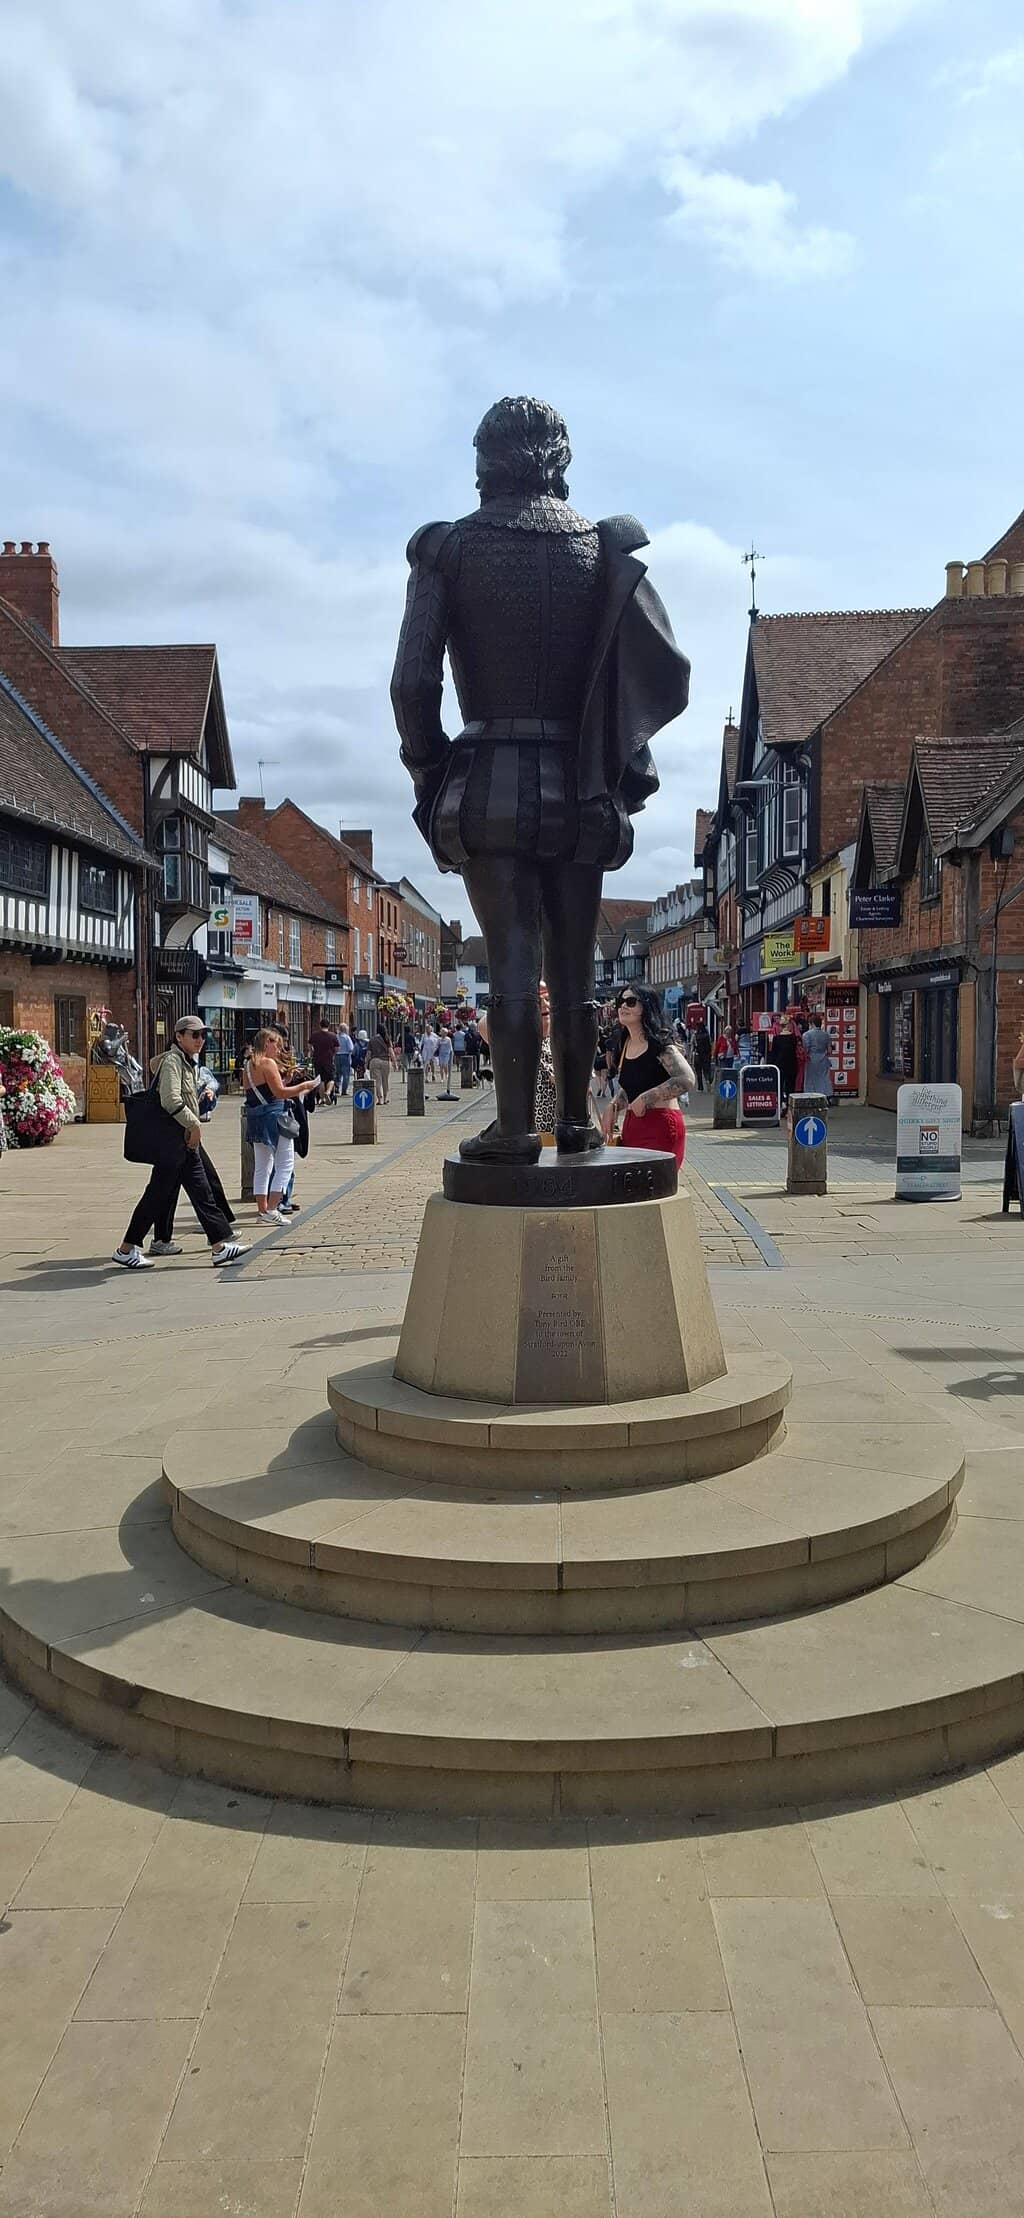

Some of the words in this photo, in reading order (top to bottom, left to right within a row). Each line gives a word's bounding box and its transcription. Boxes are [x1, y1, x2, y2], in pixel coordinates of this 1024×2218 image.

[873, 894, 896, 902] Clarke
[770, 949, 795, 957] Works
[921, 1132, 938, 1141] NO
[557, 1255, 569, 1264] gift
[545, 1264, 561, 1272] from
[563, 1264, 574, 1272] the
[557, 1274, 578, 1283] family
[538, 1310, 570, 1318] Presented
[573, 1310, 582, 1319] by
[553, 1319, 568, 1327] Bird
